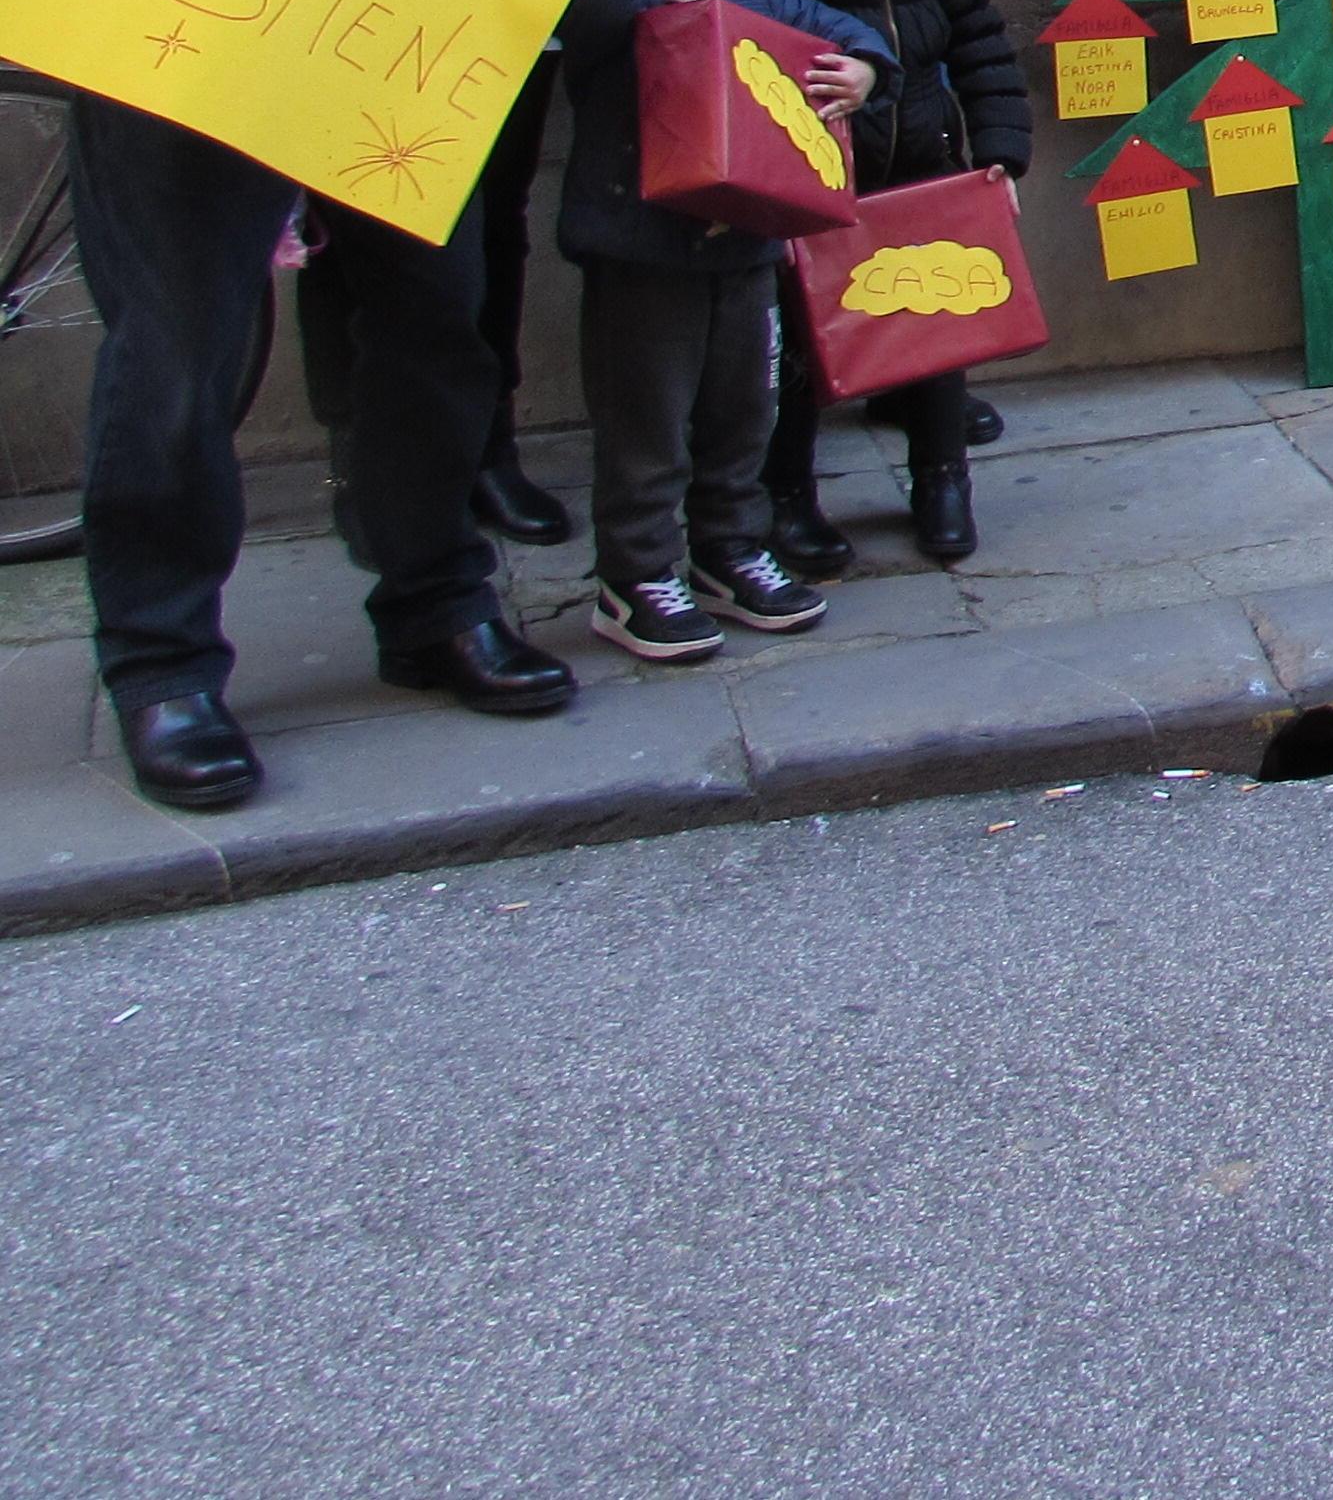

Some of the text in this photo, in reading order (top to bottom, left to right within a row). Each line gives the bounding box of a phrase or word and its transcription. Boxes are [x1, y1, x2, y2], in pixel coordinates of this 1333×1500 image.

[1197, 4, 1264, 19] BRUNELLA
[1077, 44, 1115, 60] ERIK
[1060, 60, 1133, 76] CRISTINA
[1075, 81, 1116, 94] NORA
[1067, 97, 1113, 113] ALAN
[1213, 122, 1278, 141] CRISTINA
[863, 263, 997, 298] CASA
